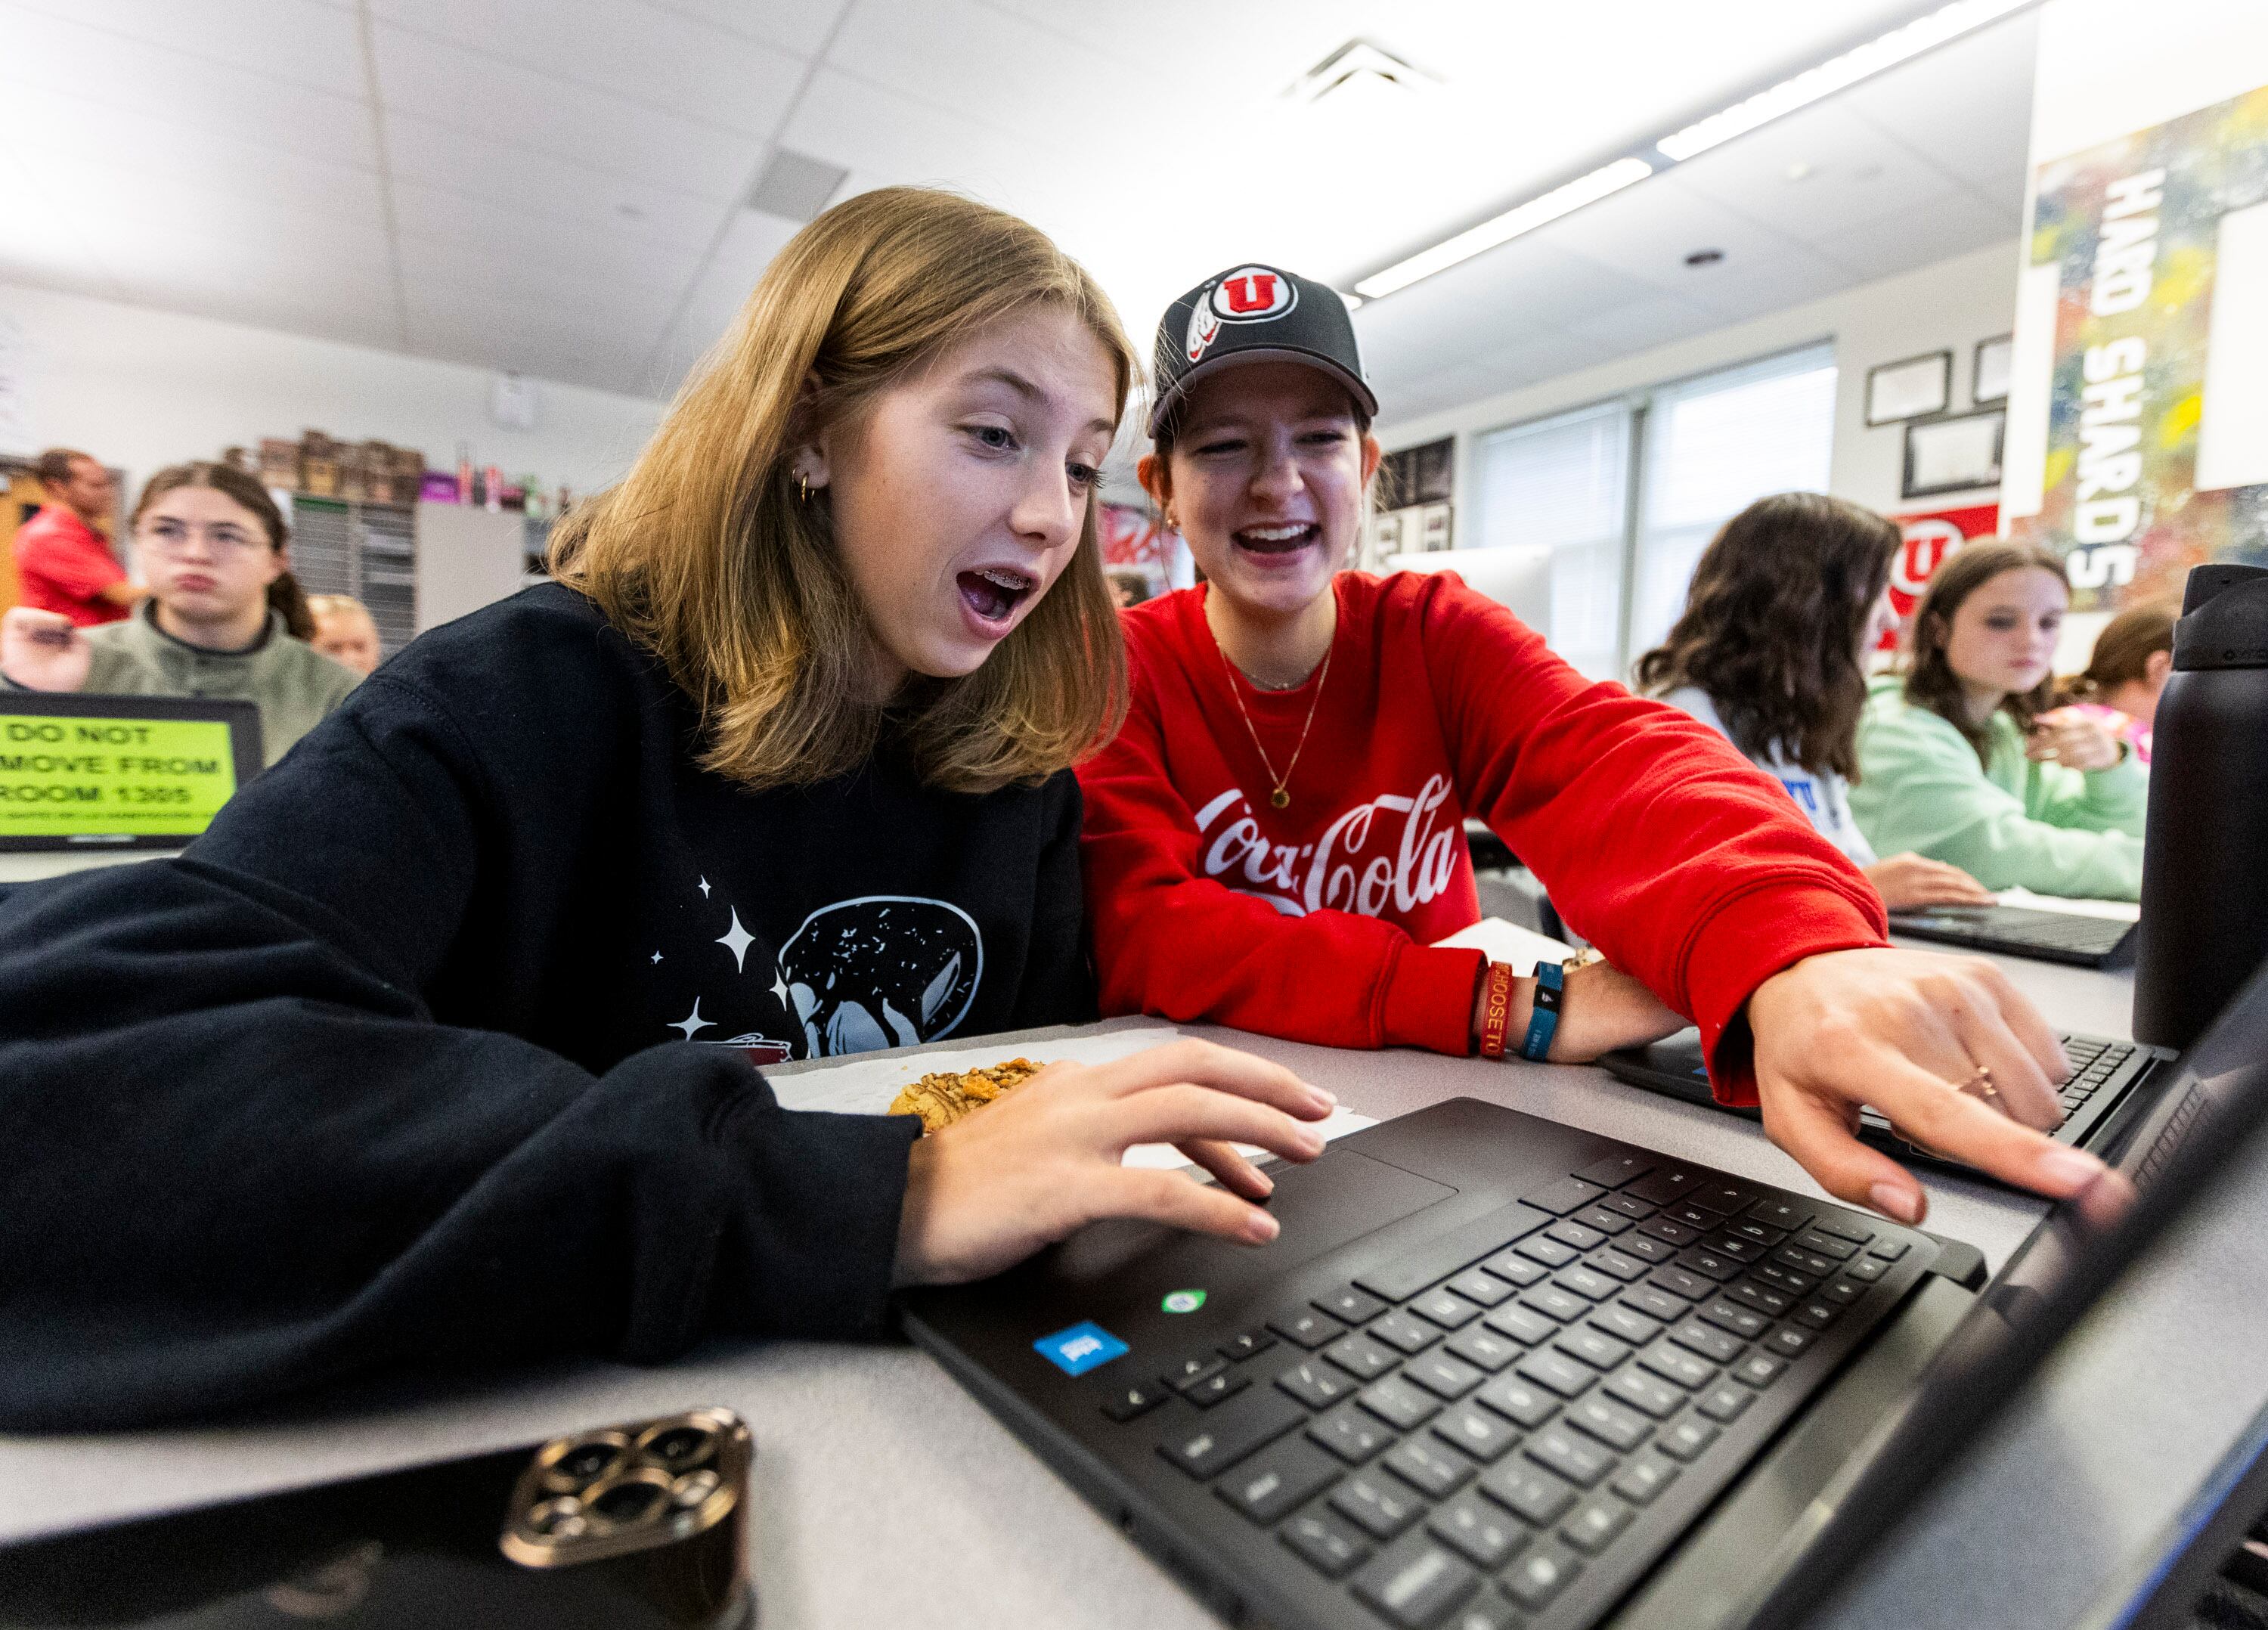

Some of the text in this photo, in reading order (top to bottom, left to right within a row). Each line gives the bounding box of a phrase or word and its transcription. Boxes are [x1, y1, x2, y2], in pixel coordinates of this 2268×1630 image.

[1222, 274, 1277, 314] U
[2065, 168, 2167, 589] HARD SHARDS
[1904, 536, 1950, 583] U
[8, 724, 150, 745] DO NOT
[119, 757, 218, 776] FROM
